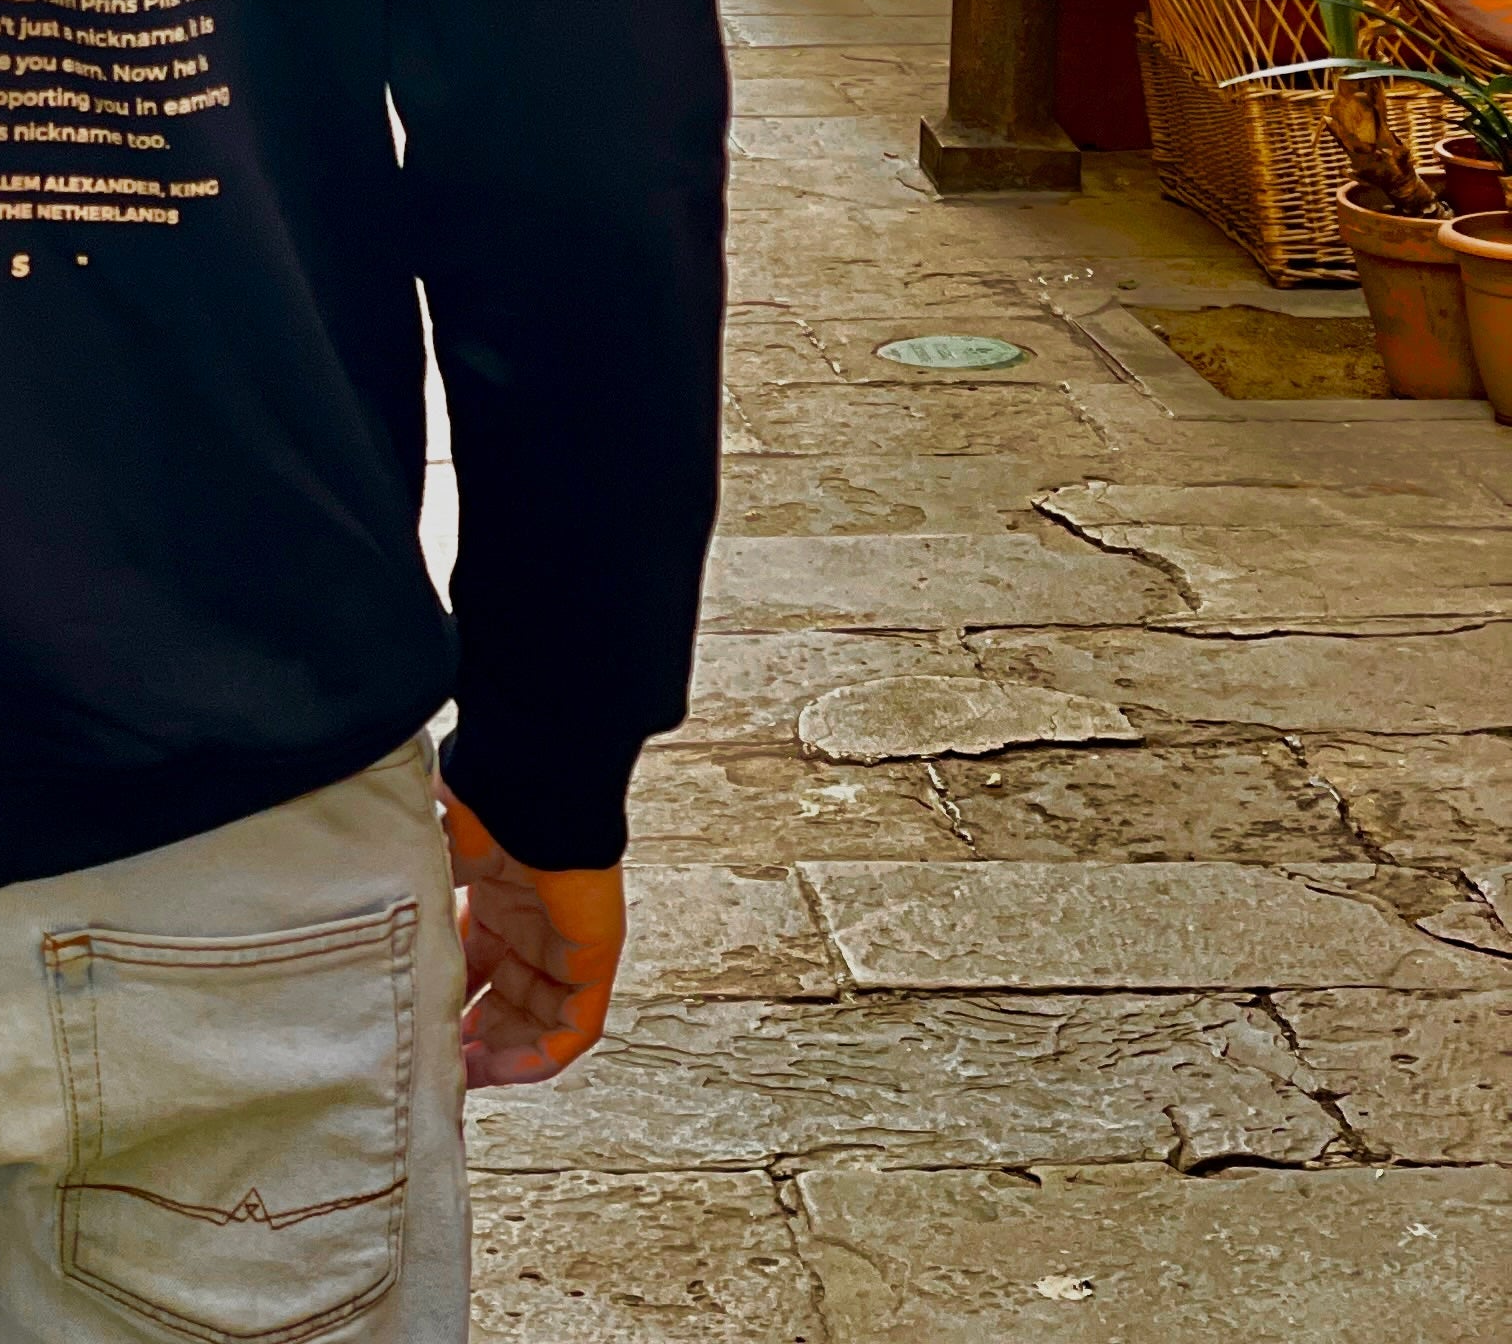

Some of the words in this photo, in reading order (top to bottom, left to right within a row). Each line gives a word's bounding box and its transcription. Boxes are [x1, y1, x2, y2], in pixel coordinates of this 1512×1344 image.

[17, 16, 61, 41] just
[199, 15, 215, 35] is
[14, 55, 57, 76] you
[112, 63, 169, 83] Now
[94, 99, 129, 116] you
[135, 97, 158, 116] in
[163, 85, 231, 116] earning
[13, 121, 123, 145] nickname
[126, 132, 170, 150] too.
[169, 179, 219, 198] KING
[36, 203, 180, 225] NETHERLANDS
